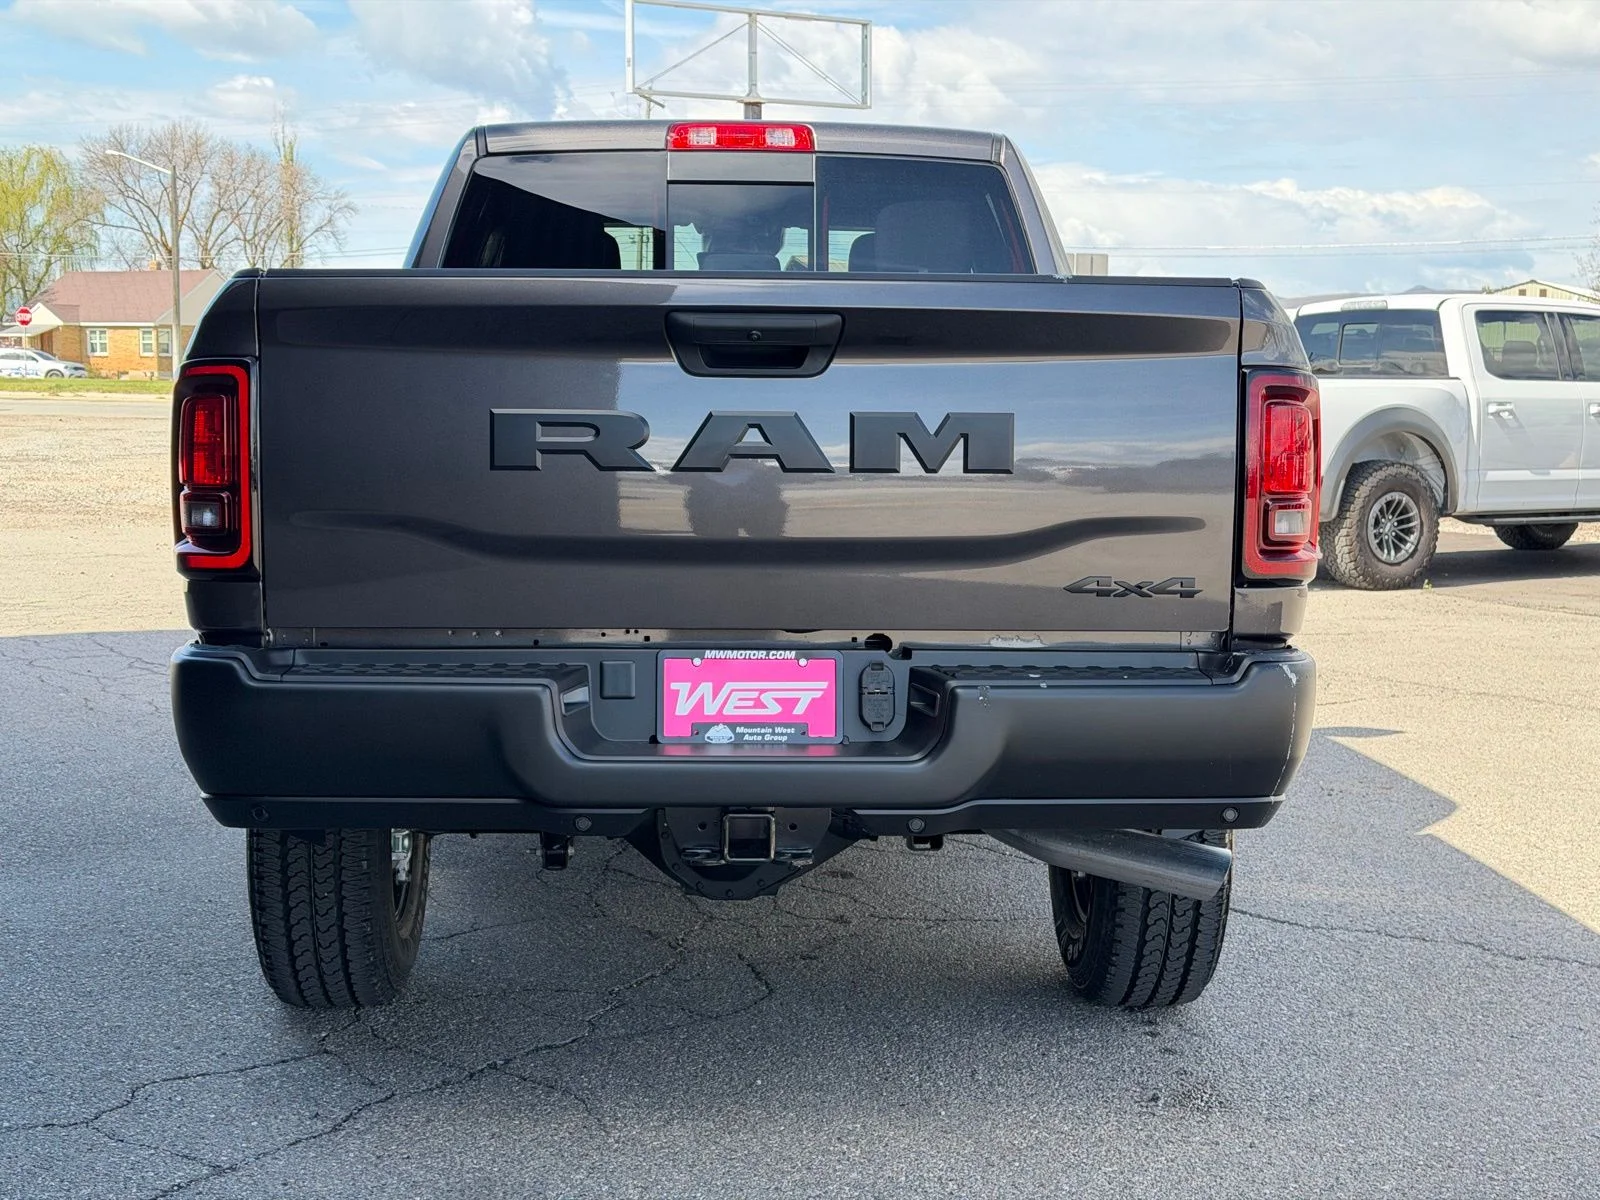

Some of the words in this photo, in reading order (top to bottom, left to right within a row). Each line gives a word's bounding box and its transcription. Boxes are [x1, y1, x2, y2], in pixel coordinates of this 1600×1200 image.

[16, 312, 32, 321] STOP
[490, 408, 1015, 474] RAM
[1063, 576, 1203, 598] 4x4
[704, 650, 796, 660] MWMOTOR.COM
[670, 682, 829, 716] WEST
[735, 726, 772, 734] Mountain
[775, 726, 796, 734] West
[764, 734, 788, 742] Group
